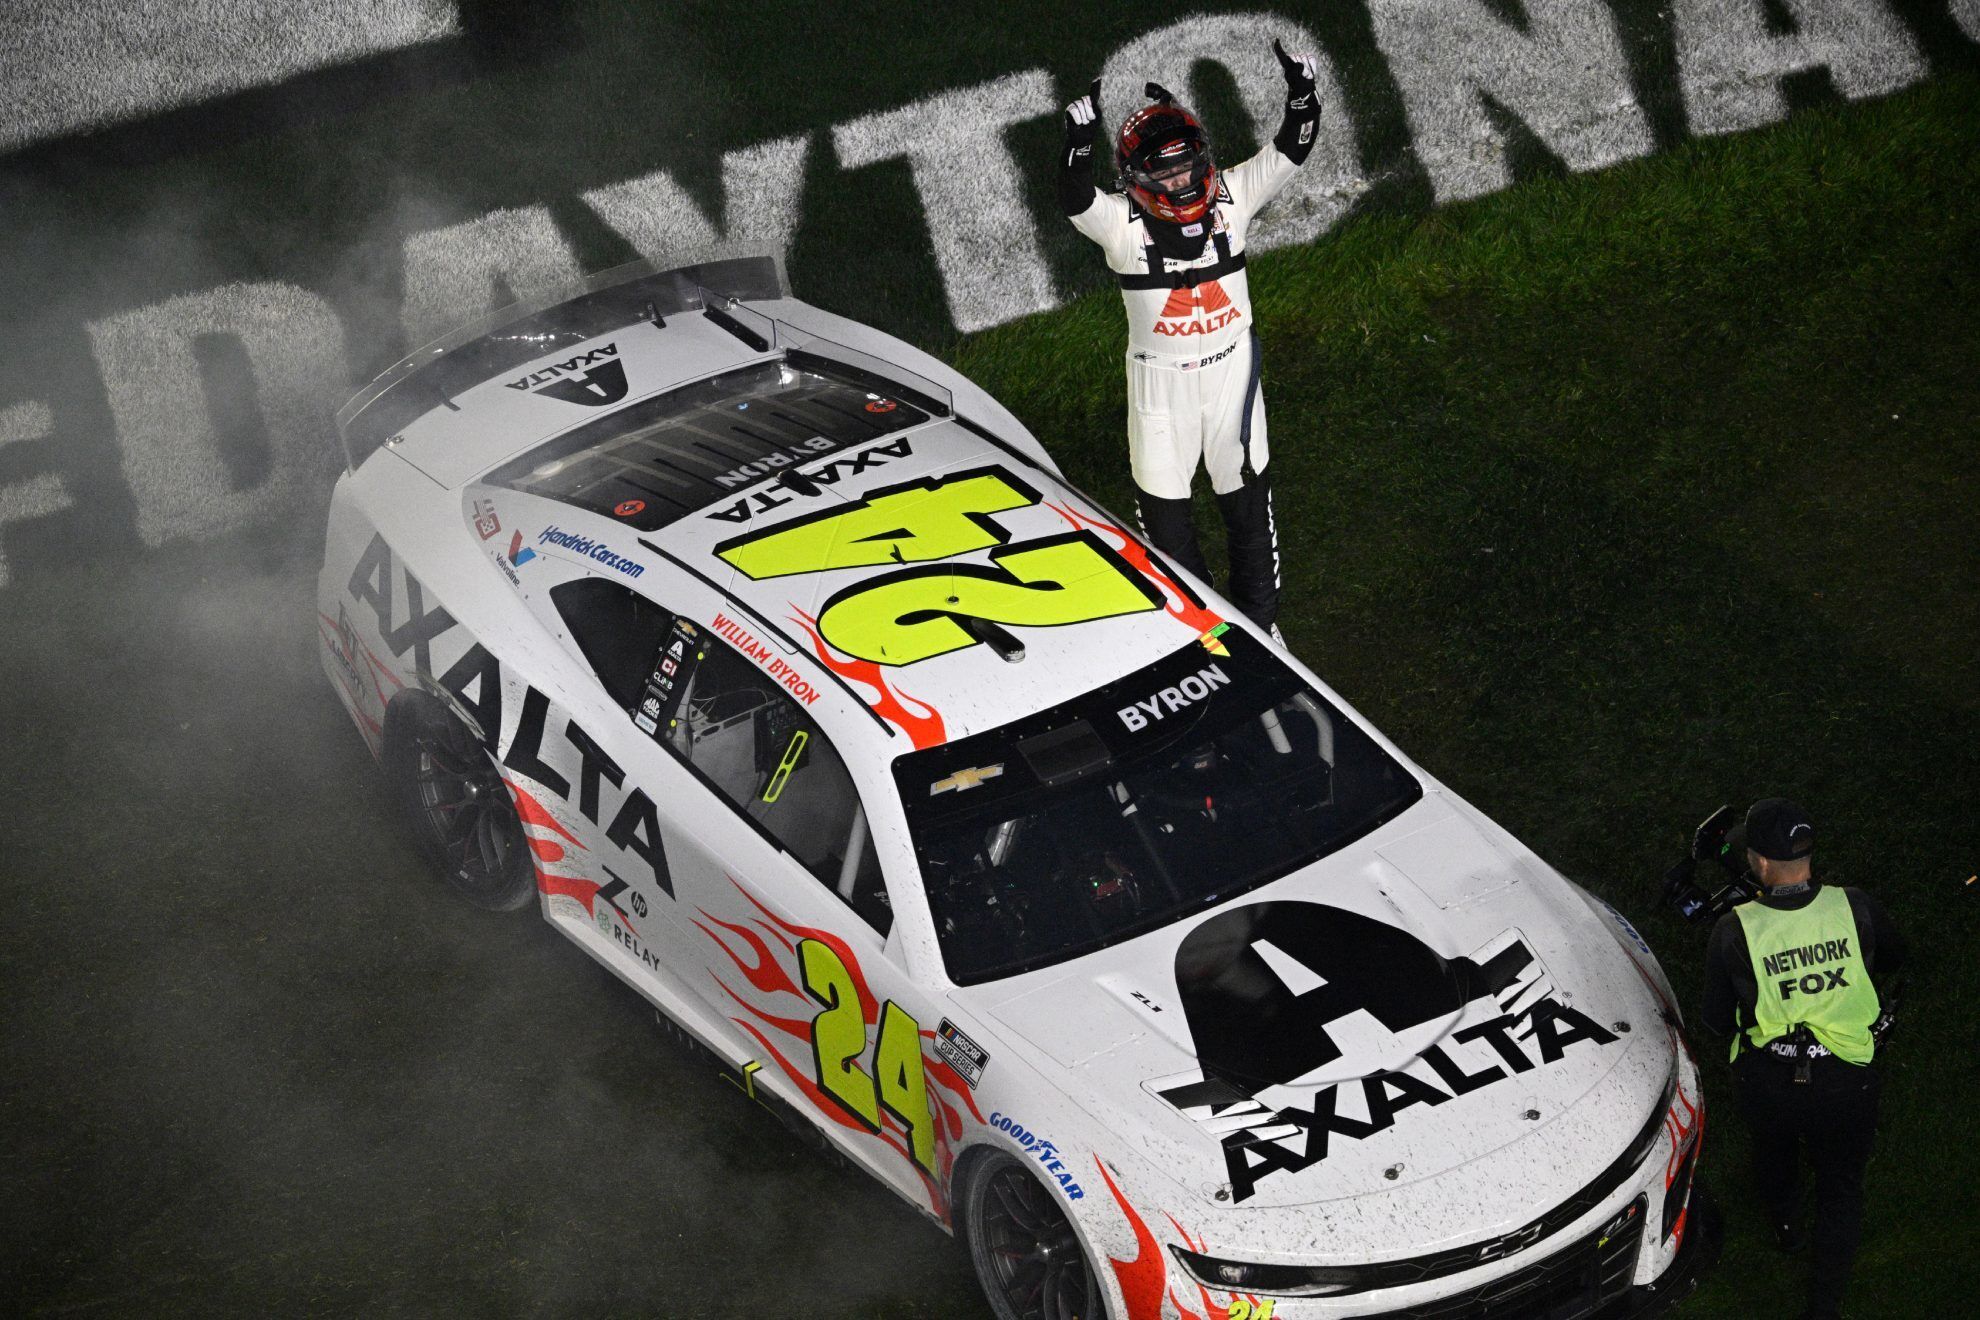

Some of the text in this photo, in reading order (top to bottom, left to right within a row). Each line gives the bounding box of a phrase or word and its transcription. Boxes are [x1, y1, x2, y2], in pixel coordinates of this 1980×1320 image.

[1152, 306, 1242, 337] AXALTA
[504, 342, 618, 391] AXALTA
[1199, 341, 1237, 368] BYRON
[714, 435, 837, 488] BYRON
[711, 463, 1168, 668] 24
[711, 611, 821, 707] WILLIAM BYRON
[346, 531, 677, 902] AXALTA
[1115, 663, 1232, 734] BYRON
[614, 923, 660, 972] RELAY
[1762, 937, 1852, 977] NETWORK
[1778, 966, 1851, 1002] FOX
[796, 937, 943, 1186] 24
[940, 1041, 975, 1077] CUP SERIES
[952, 1033, 982, 1062] NASCAR
[1220, 996, 1621, 1205] AXALTA
[989, 1111, 1085, 1201] GOODYEAR
